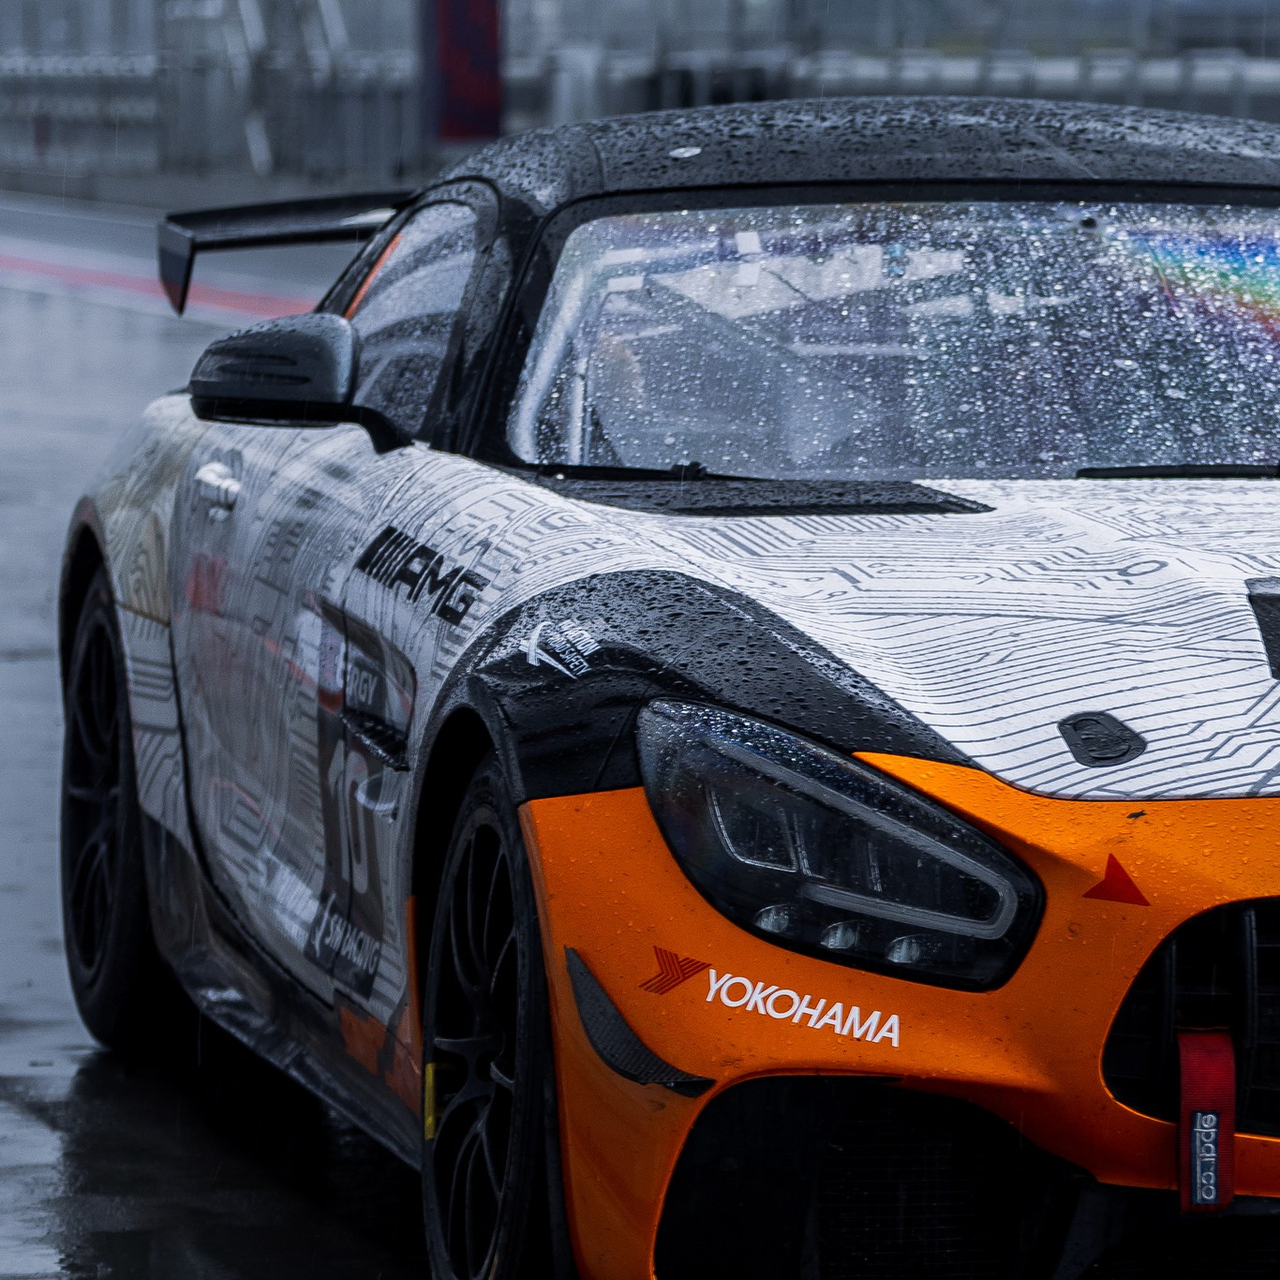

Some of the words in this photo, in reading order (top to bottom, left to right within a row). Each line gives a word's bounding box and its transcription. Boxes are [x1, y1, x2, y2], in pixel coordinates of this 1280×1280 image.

[384, 543, 491, 625] AMG
[559, 648, 592, 675] SAFETY
[706, 969, 899, 1047] YOKOHAMA
